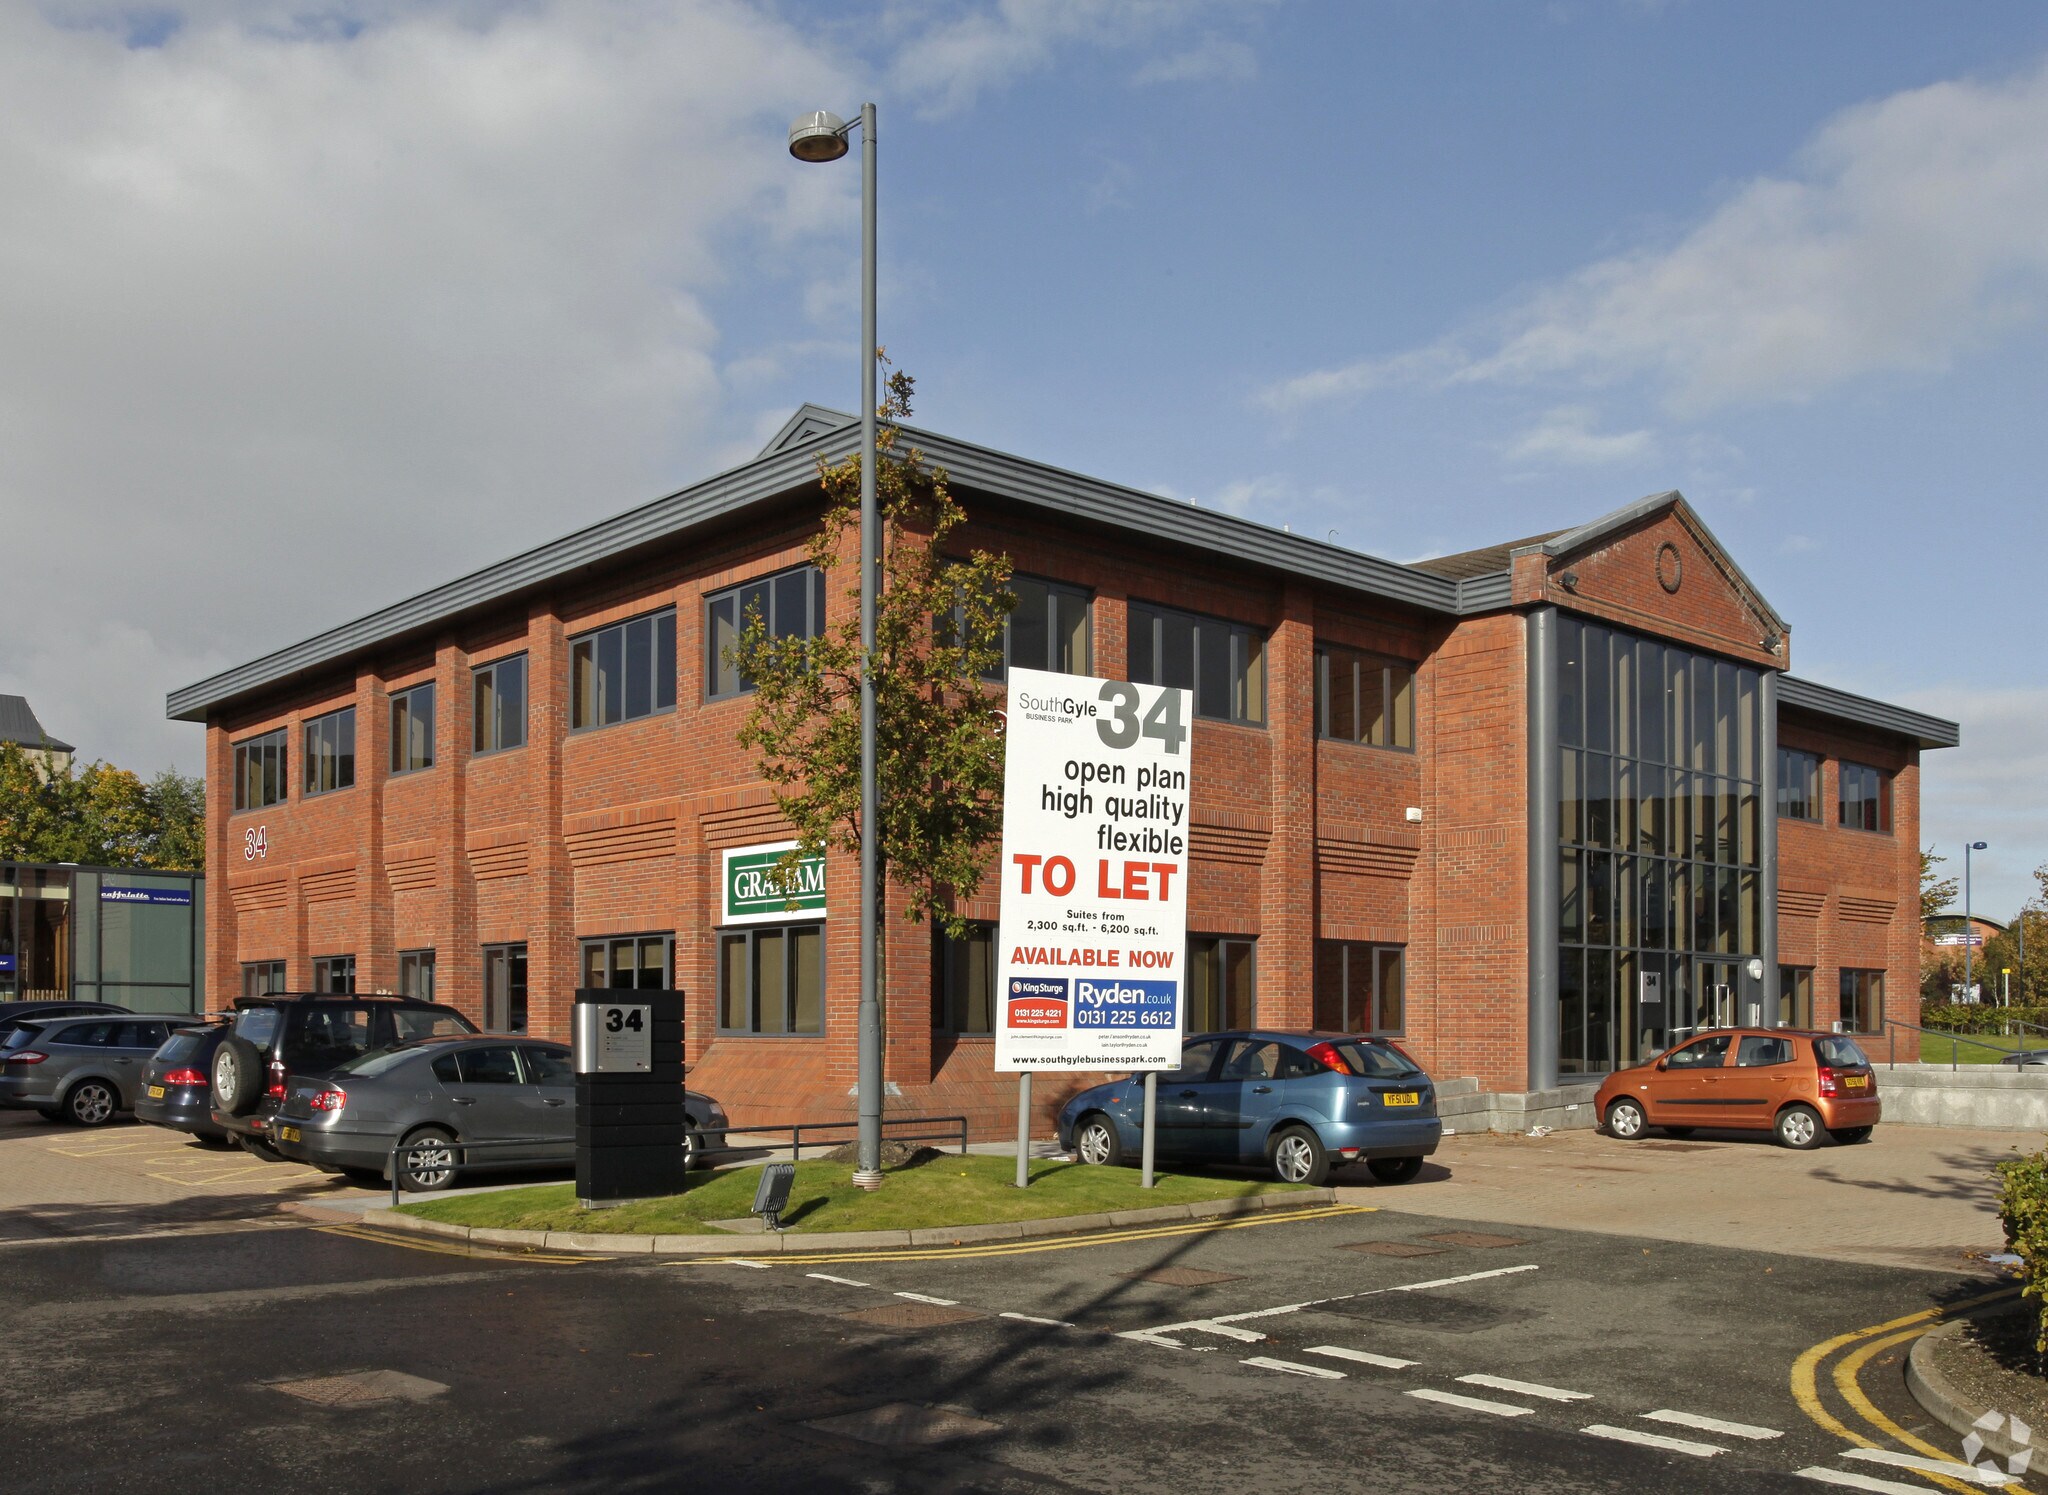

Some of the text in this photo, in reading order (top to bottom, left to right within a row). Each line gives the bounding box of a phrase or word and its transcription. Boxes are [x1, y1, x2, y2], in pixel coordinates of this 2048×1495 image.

[1019, 693, 1097, 718] SouthGyle
[1096, 680, 1187, 755] 34
[1026, 713, 1073, 724] BUSINESS PARK
[1064, 760, 1185, 791] open plan
[1042, 784, 1184, 826] high quality
[244, 825, 268, 860] 34
[1097, 824, 1183, 855] flexible
[1013, 853, 1178, 901] TO LET
[1066, 909, 1125, 921] Suites from
[1027, 920, 1058, 931] 2,300
[1062, 923, 1088, 932] sq.ft.
[1100, 924, 1130, 934] 6,200
[1134, 926, 1159, 936] sq.ft.
[1011, 946, 1174, 969] AVAILABLE NOW
[1646, 975, 1657, 986] 34
[1078, 982, 1172, 1008] Ryden.co.uk
[606, 1008, 643, 1032] 34
[1014, 1009, 1030, 1017] 0131
[1031, 1009, 1044, 1017] 225
[1078, 1010, 1172, 1025] 0131 225 6612
[1012, 1055, 1166, 1065] www.southgylebusinesspark.com
